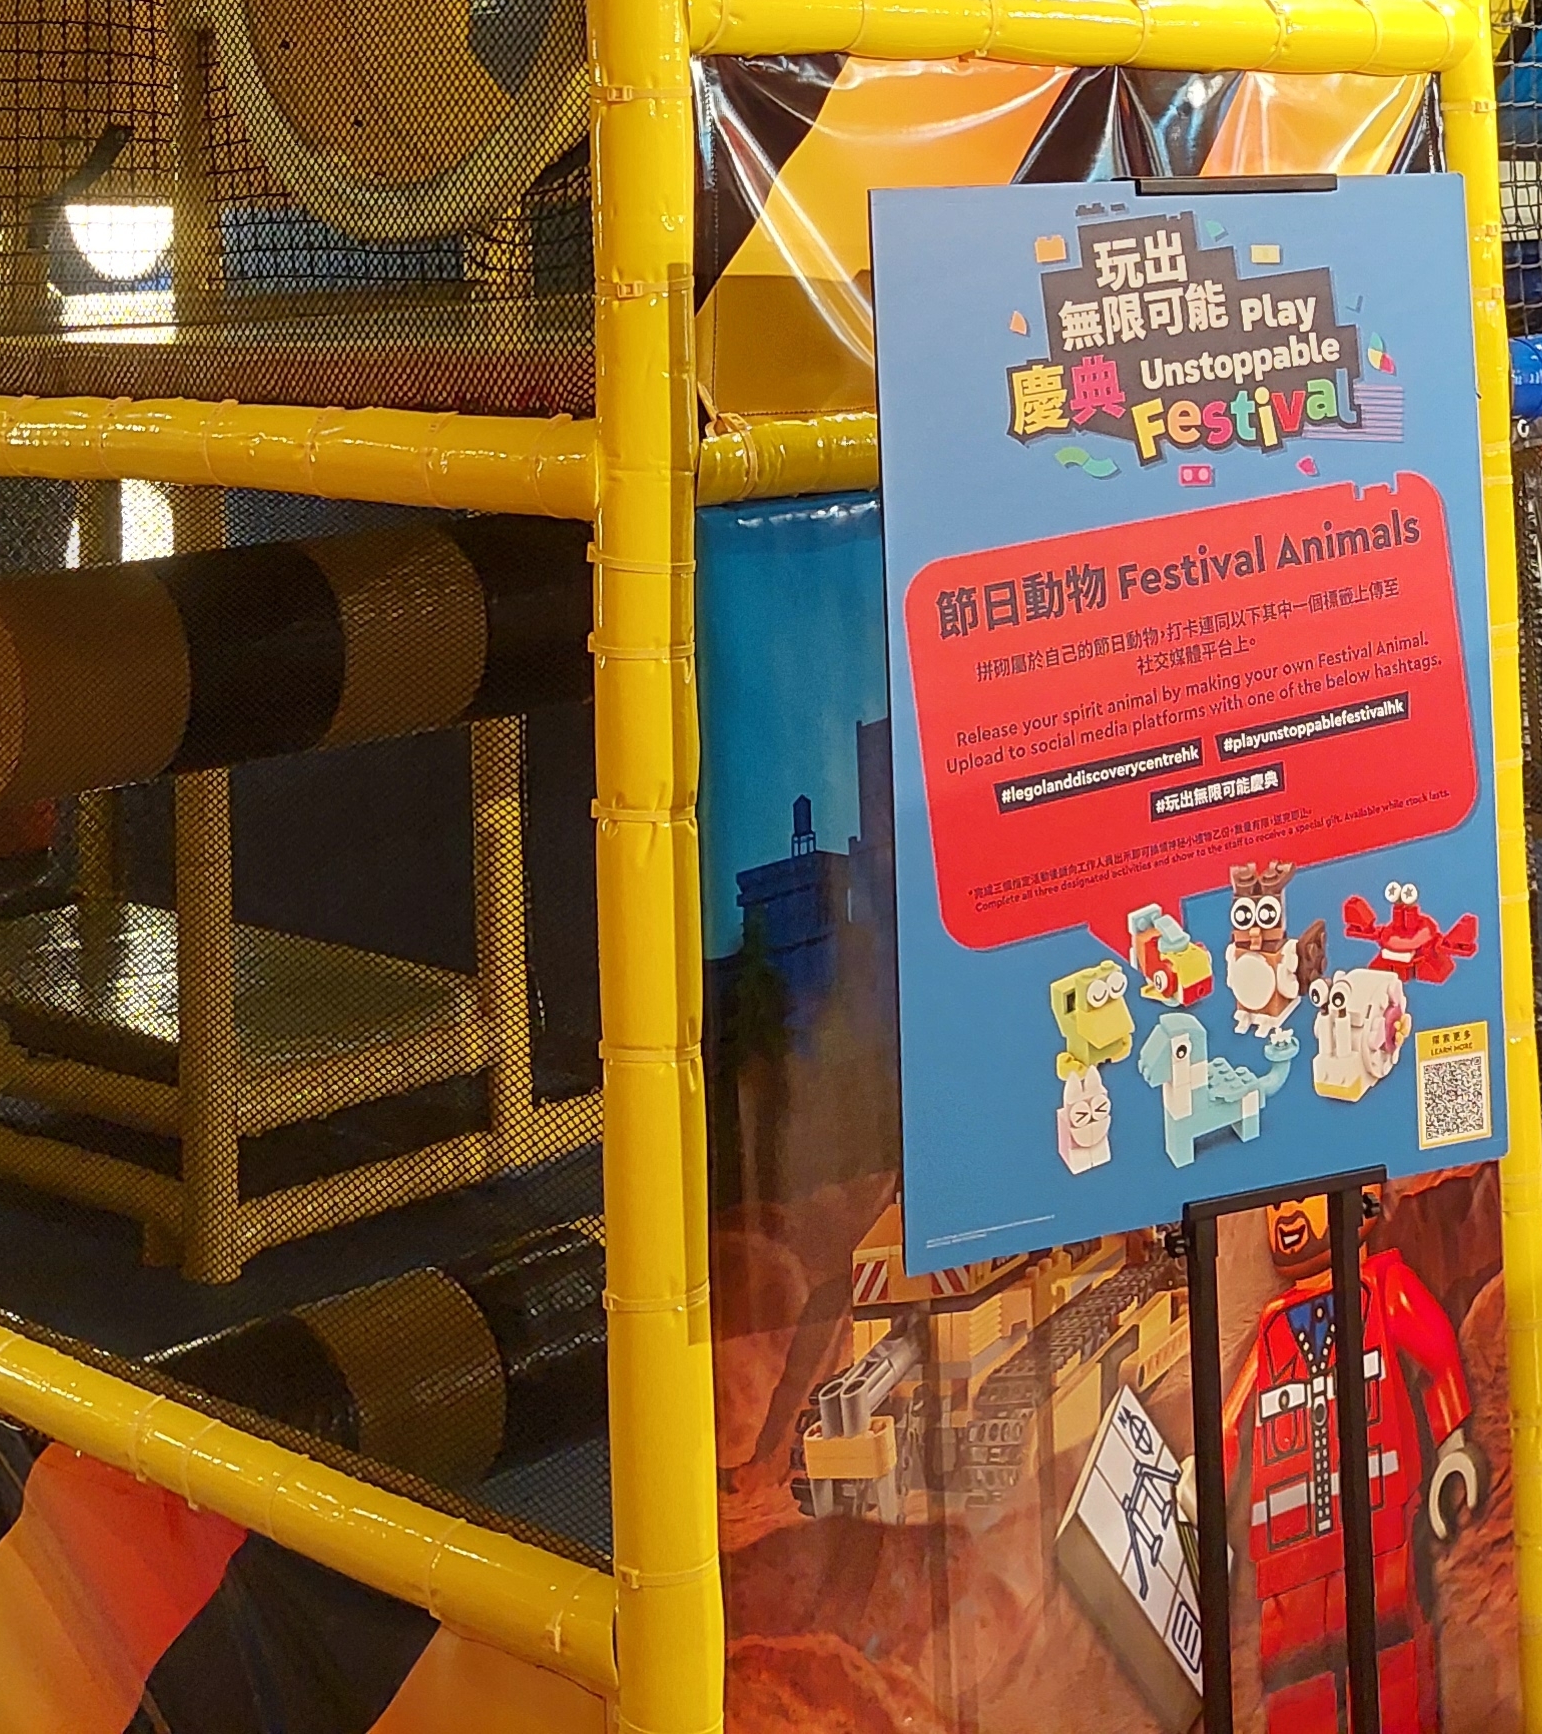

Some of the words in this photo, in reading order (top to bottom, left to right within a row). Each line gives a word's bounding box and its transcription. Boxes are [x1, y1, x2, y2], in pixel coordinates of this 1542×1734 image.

[1093, 230, 1189, 290] 玩出
[1058, 280, 1229, 351] 無限可能
[1240, 293, 1317, 333] Play
[1011, 355, 1126, 435] 慶典
[1139, 332, 1340, 390] Unstoppable
[1131, 368, 1358, 460] Festival
[936, 563, 1106, 639] 節日動物
[1118, 535, 1266, 599] Festival
[1277, 509, 1420, 569] Animals
[947, 747, 1004, 774] Upload
[1008, 743, 1026, 760] to
[1031, 730, 1076, 755] social
[1080, 720, 1128, 744] media
[1132, 703, 1206, 735] platforms
[1209, 695, 1243, 715] with
[1248, 691, 1274, 706] one
[1279, 683, 1296, 700] of
[1297, 678, 1322, 695] the
[1326, 667, 1370, 690] below
[1374, 653, 1442, 679] hashtags.
[957, 720, 1018, 747] Release
[1023, 714, 1058, 736] your
[1063, 701, 1103, 728] spirit
[1108, 689, 1158, 713] animal
[1163, 682, 1181, 704] by
[1186, 673, 1240, 699] making
[1245, 665, 1278, 687] your
[1283, 658, 1314, 675] own
[1319, 642, 1372, 668] Festival
[1377, 631, 1429, 656] Animal.
[1001, 745, 1200, 804] #legolanddiscoverycentrehk
[1223, 699, 1405, 752] #playunstoppablefestivalhk
[1155, 769, 1279, 814] #玩出無限可能慶典
[975, 893, 1020, 913] Complete
[1022, 888, 1033, 901] all
[1035, 885, 1059, 897] three
[1061, 871, 1109, 891] designated
[1112, 861, 1152, 878] activities
[1154, 856, 1170, 867] and
[1172, 850, 1194, 862] show
[1196, 847, 1206, 857] to
[1208, 844, 1222, 855] the
[1225, 837, 1243, 850] staff
[1244, 836, 1254, 845] to
[1256, 829, 1286, 842] receive
[1295, 817, 1324, 834] special
[1344, 806, 1381, 821] Available
[1382, 799, 1404, 811] while
[1406, 792, 1429, 805] stock
